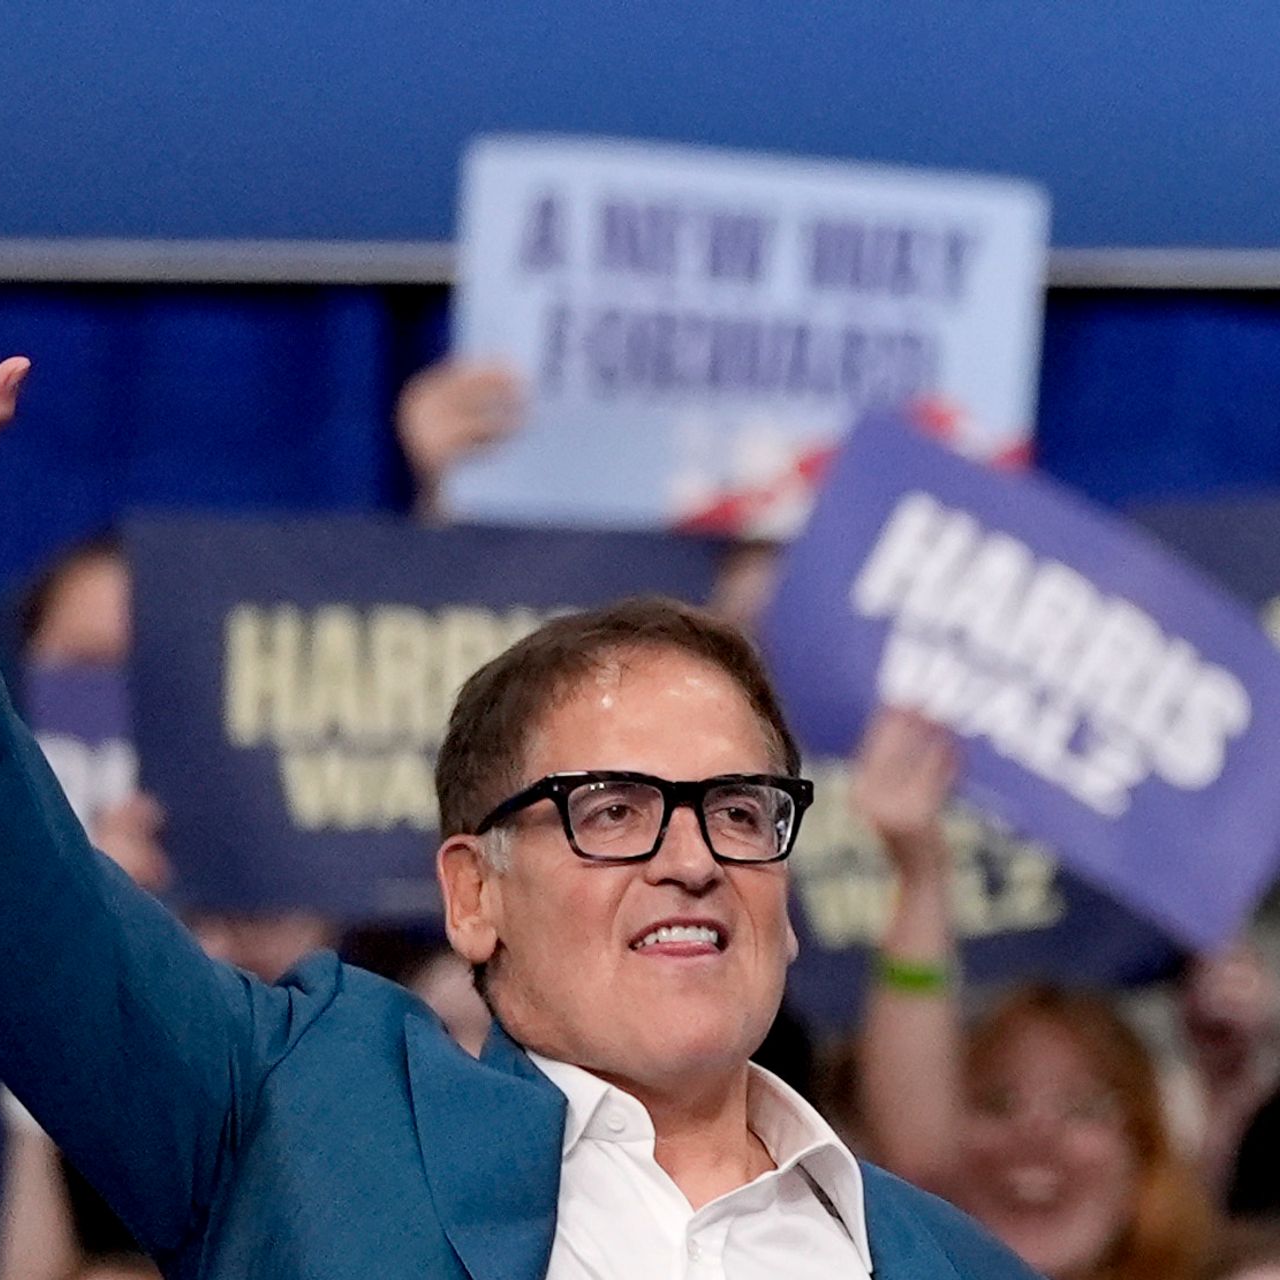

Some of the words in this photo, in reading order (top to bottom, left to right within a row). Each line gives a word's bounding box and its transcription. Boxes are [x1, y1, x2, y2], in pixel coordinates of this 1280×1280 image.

[520, 190, 576, 275] A
[592, 196, 775, 286] NEW
[800, 210, 976, 306] WAY
[850, 490, 1253, 792] HARRIS
[878, 625, 1132, 820] WALZ
